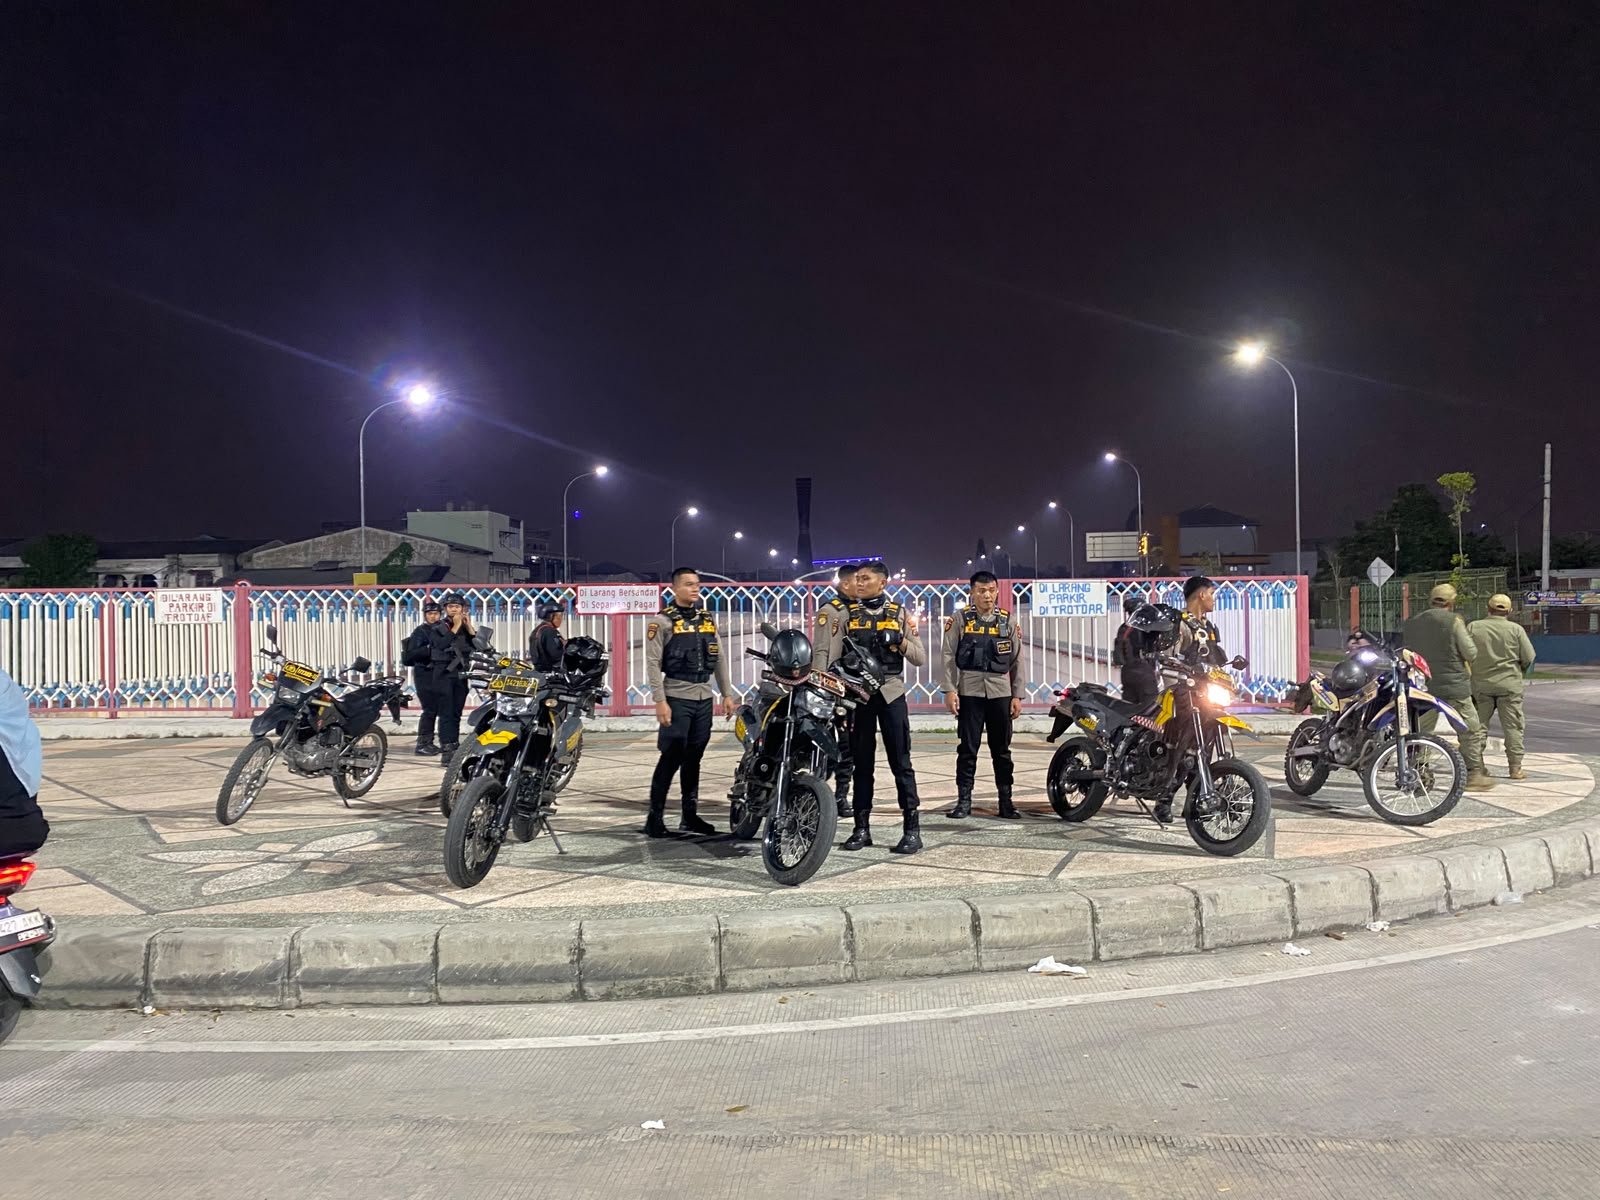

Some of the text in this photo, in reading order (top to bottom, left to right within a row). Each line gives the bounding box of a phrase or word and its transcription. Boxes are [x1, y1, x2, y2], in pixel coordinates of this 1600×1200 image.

[580, 588, 658, 598] Di Larang Bersandar
[1039, 583, 1091, 593] DI LARANG
[1048, 593, 1087, 604] PARKIR
[168, 603, 216, 612] PARKIR DI
[581, 600, 589, 609] Di
[634, 601, 657, 610] Pagar
[1039, 603, 1105, 615] DI TROTOAR
